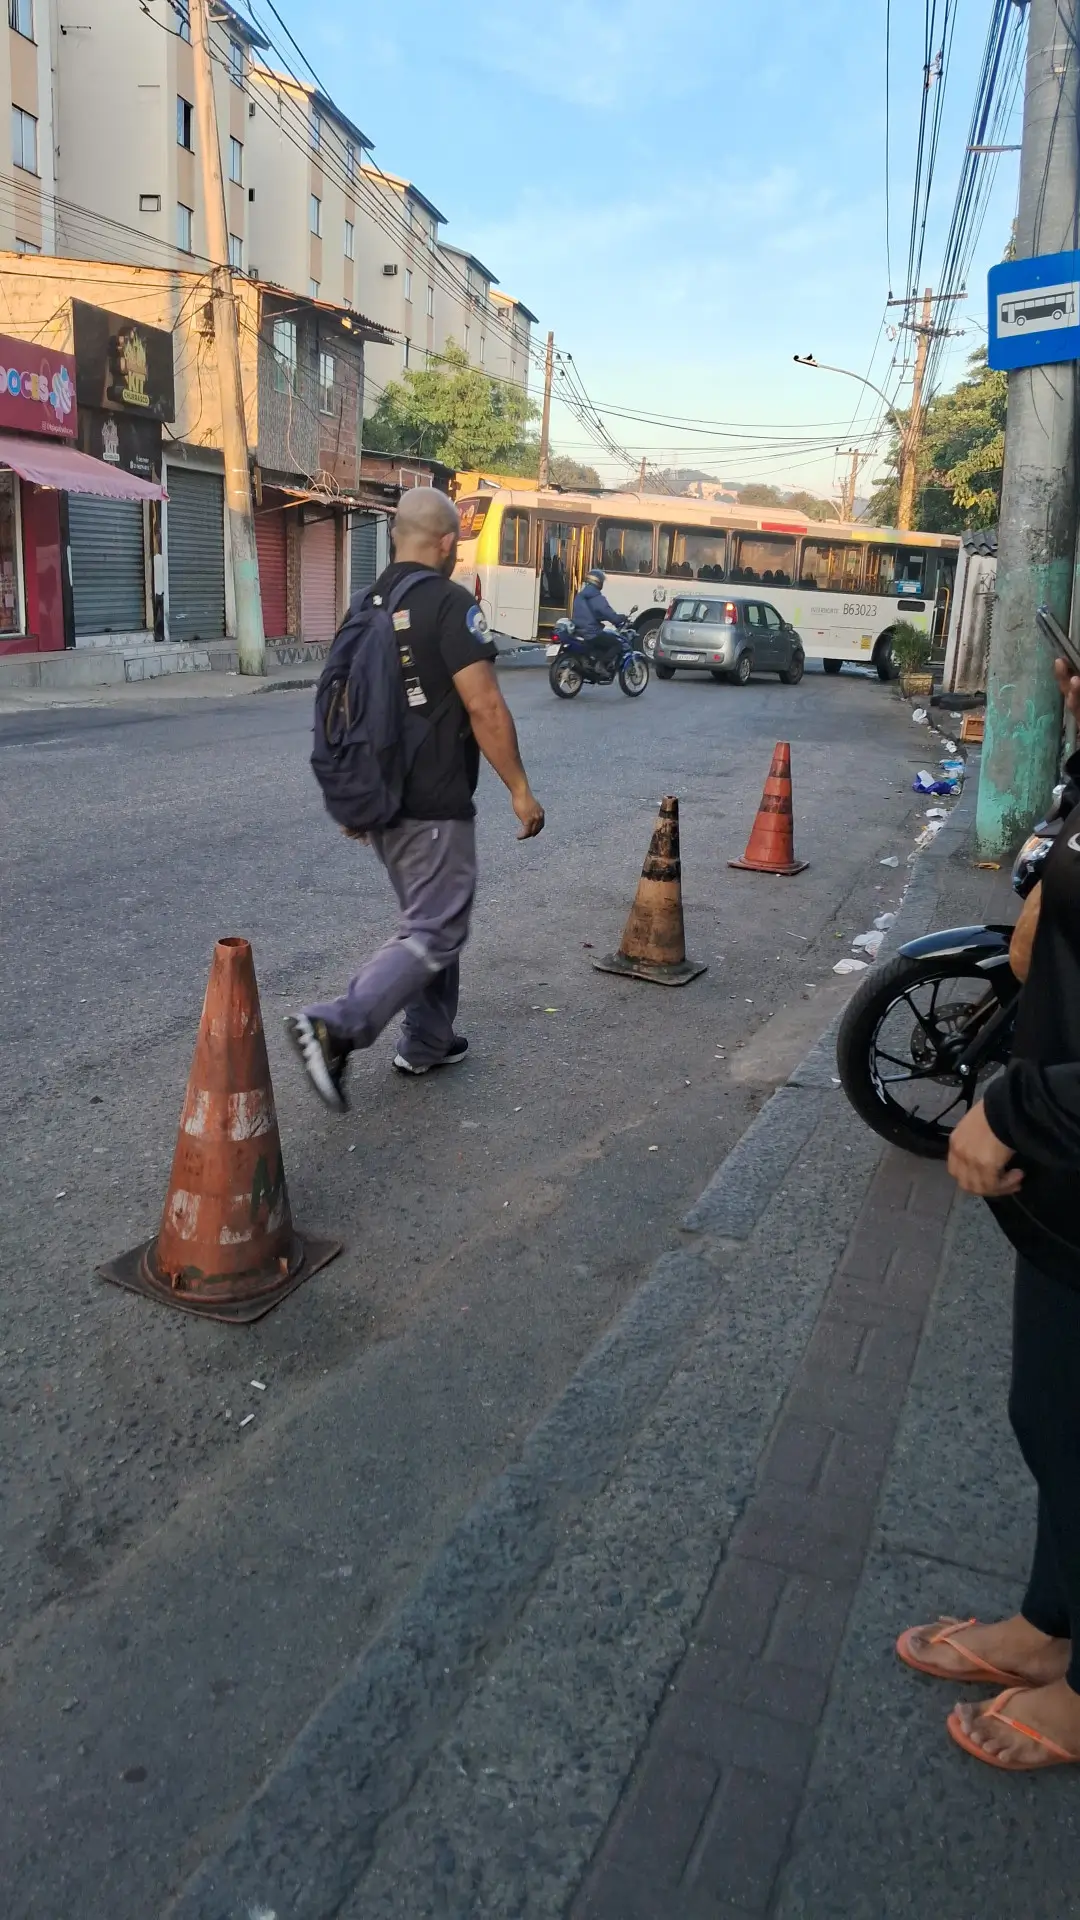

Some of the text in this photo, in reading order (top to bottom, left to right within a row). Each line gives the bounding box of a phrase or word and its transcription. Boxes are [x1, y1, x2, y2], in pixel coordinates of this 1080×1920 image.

[128, 371, 146, 395] KIT
[123, 390, 149, 405] CHURRASCO
[842, 602, 878, 617] B63023
